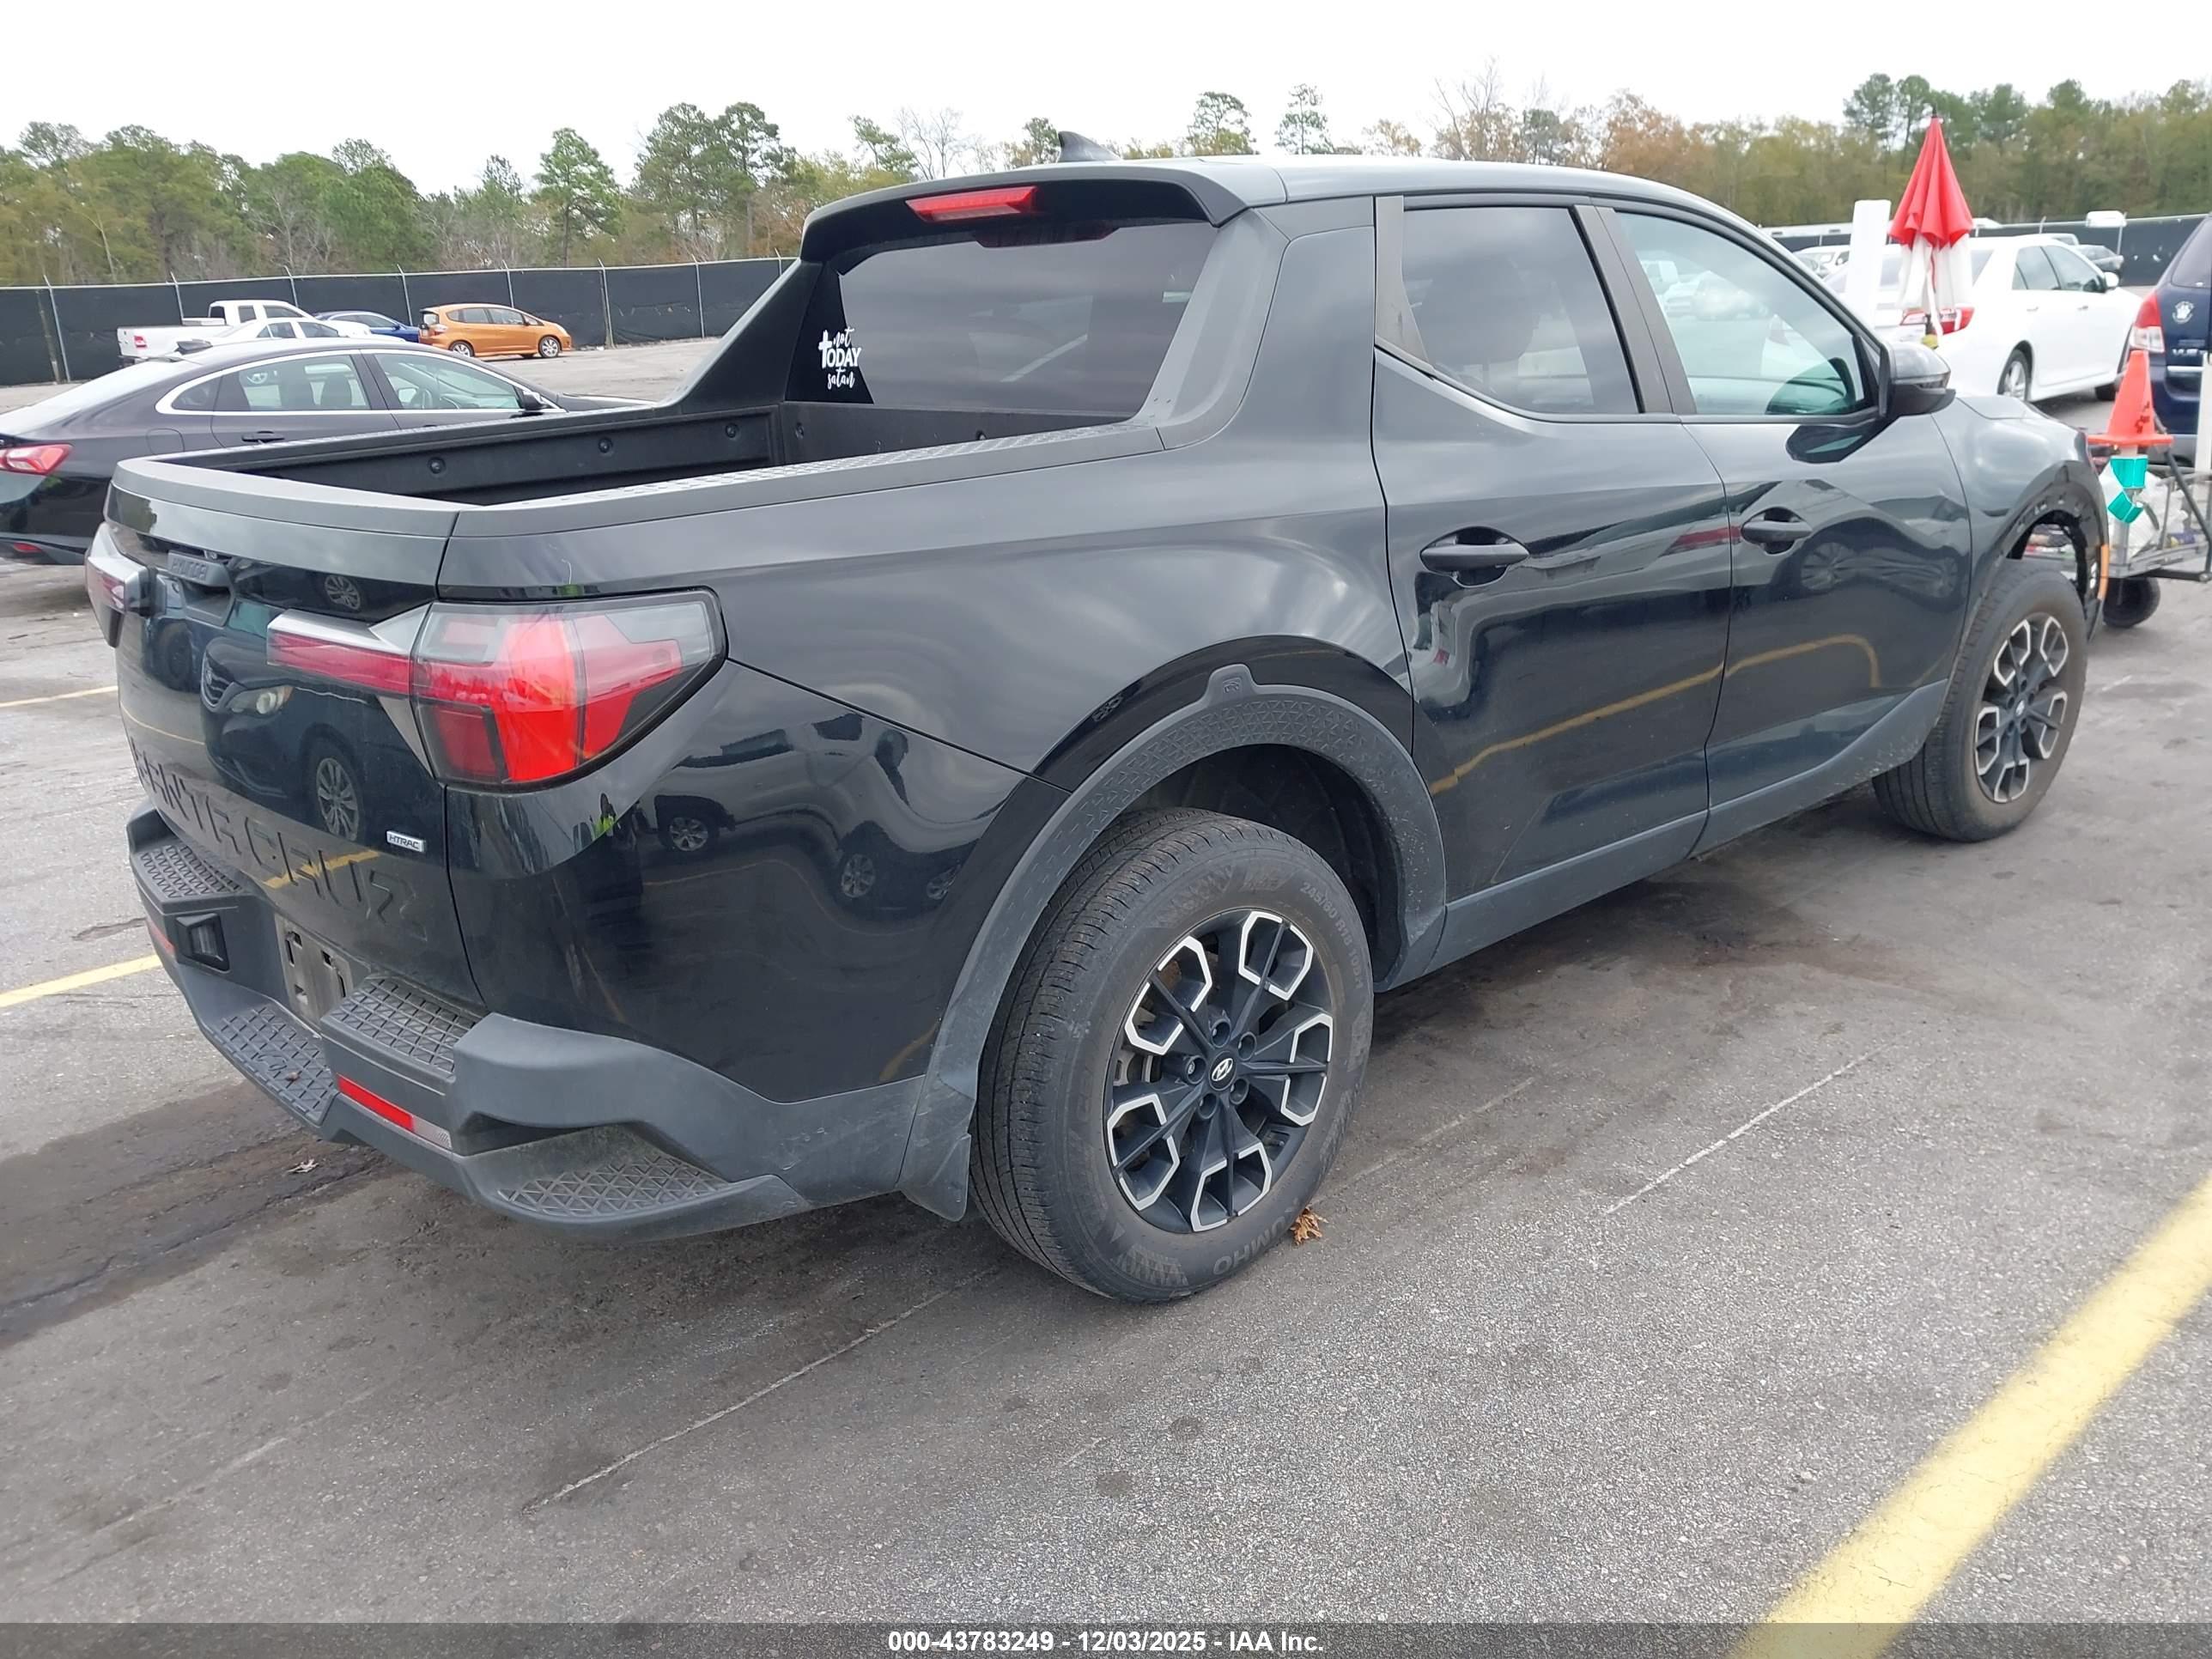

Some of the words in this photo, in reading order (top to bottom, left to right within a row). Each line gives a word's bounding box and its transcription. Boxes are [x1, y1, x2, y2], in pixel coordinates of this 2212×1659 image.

[832, 325, 855, 348] not
[817, 329, 862, 369] TODAY
[827, 367, 855, 390] satan
[389, 834, 420, 850] HTRAC
